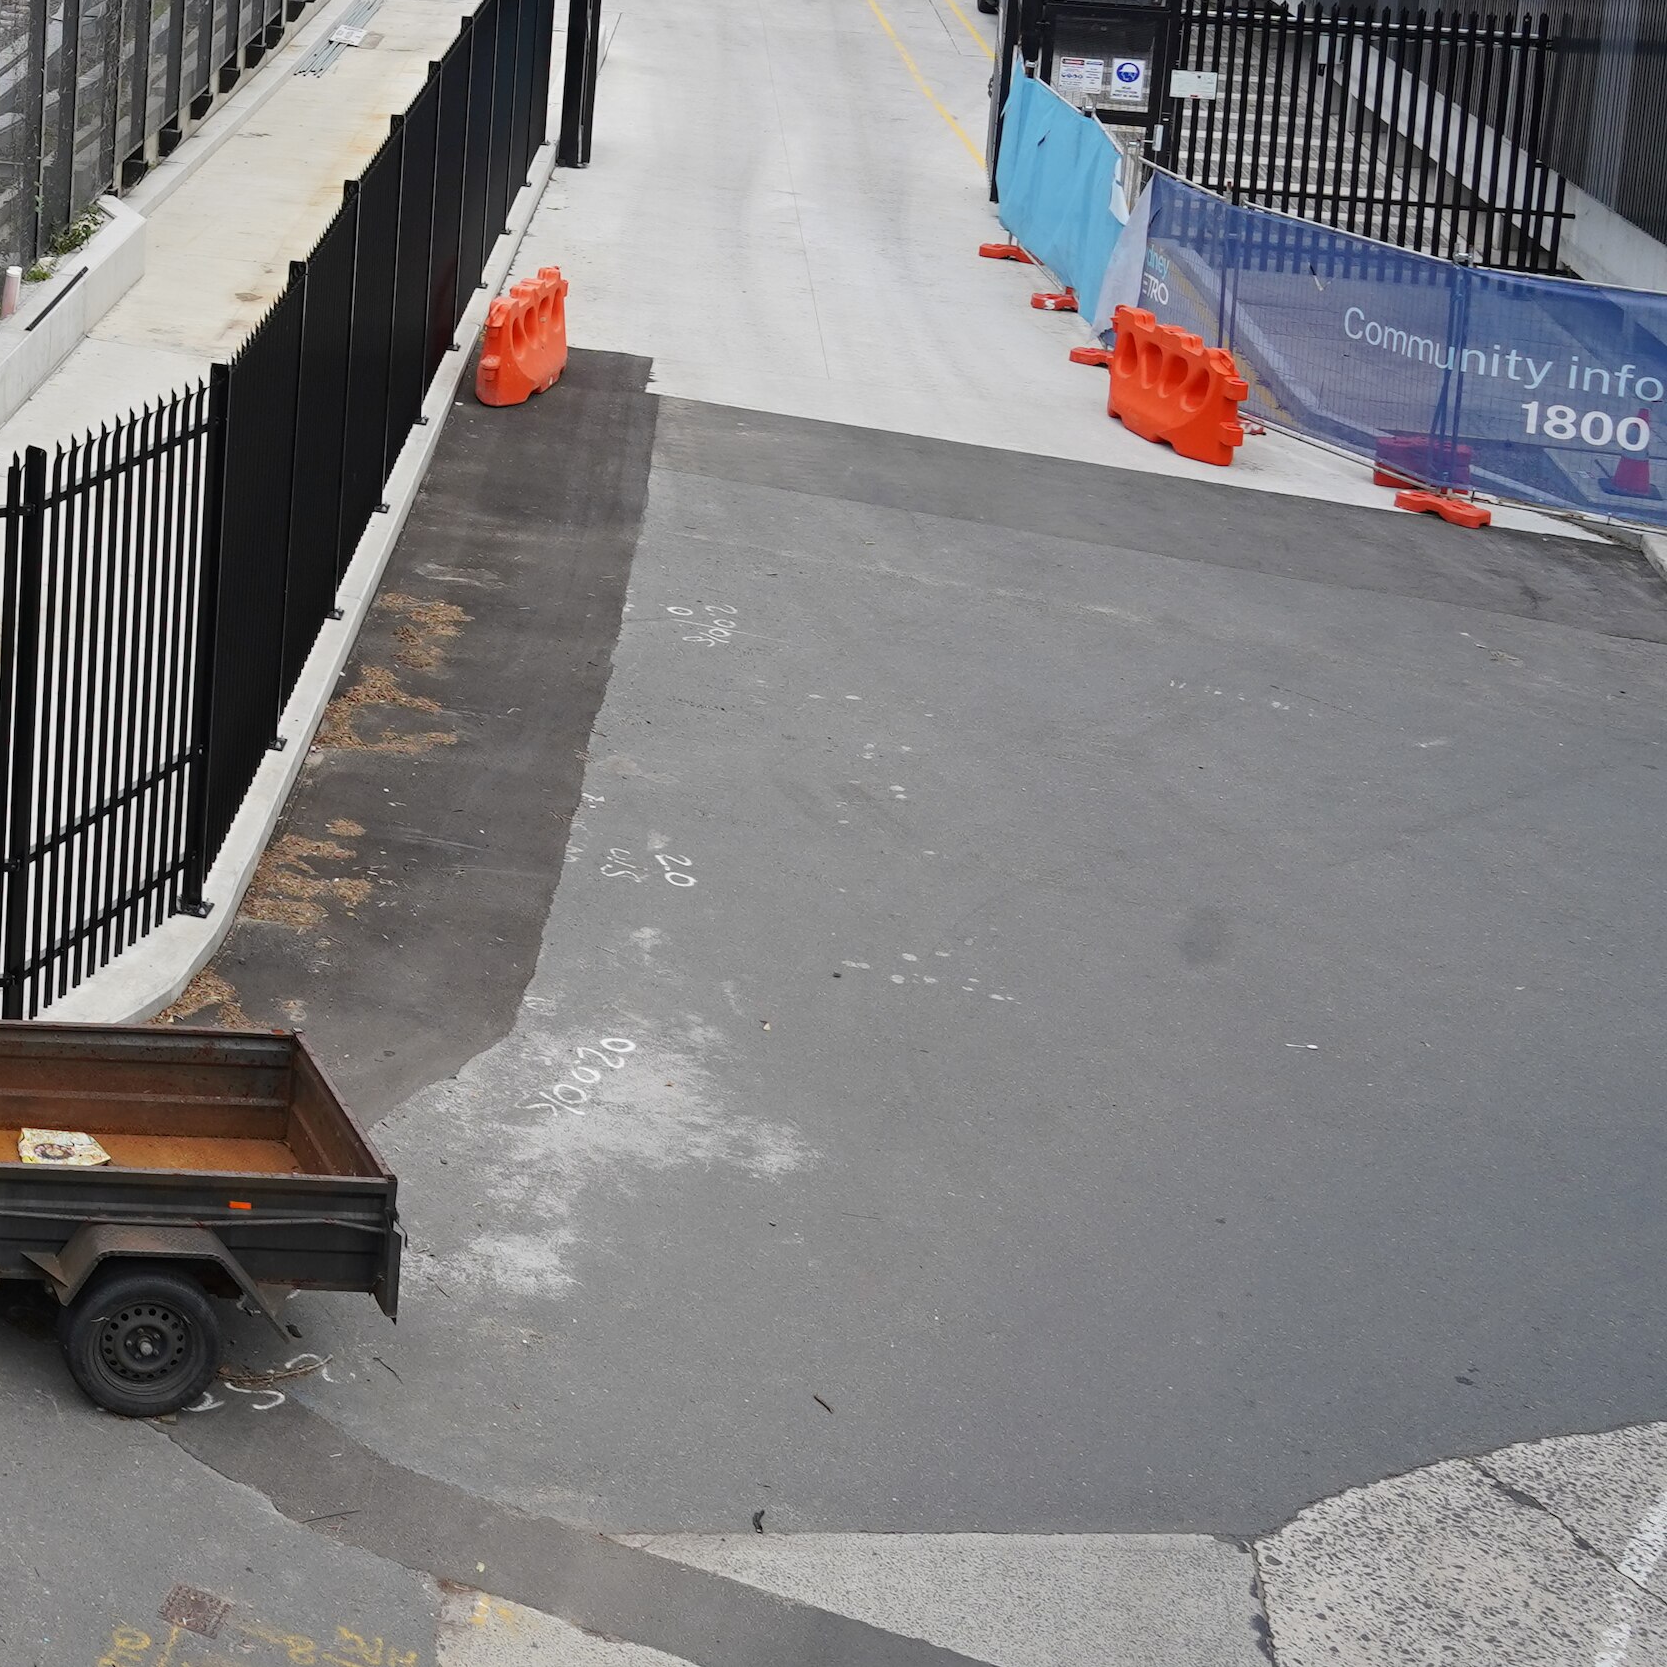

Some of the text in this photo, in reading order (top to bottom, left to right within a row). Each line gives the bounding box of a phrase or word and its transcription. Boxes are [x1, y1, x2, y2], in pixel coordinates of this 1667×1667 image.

[1147, 244, 1170, 280] dney
[1142, 272, 1169, 305] ETRO
[1344, 306, 1553, 390] Community
[1568, 356, 1664, 402] info
[1521, 400, 1651, 452] 1800
